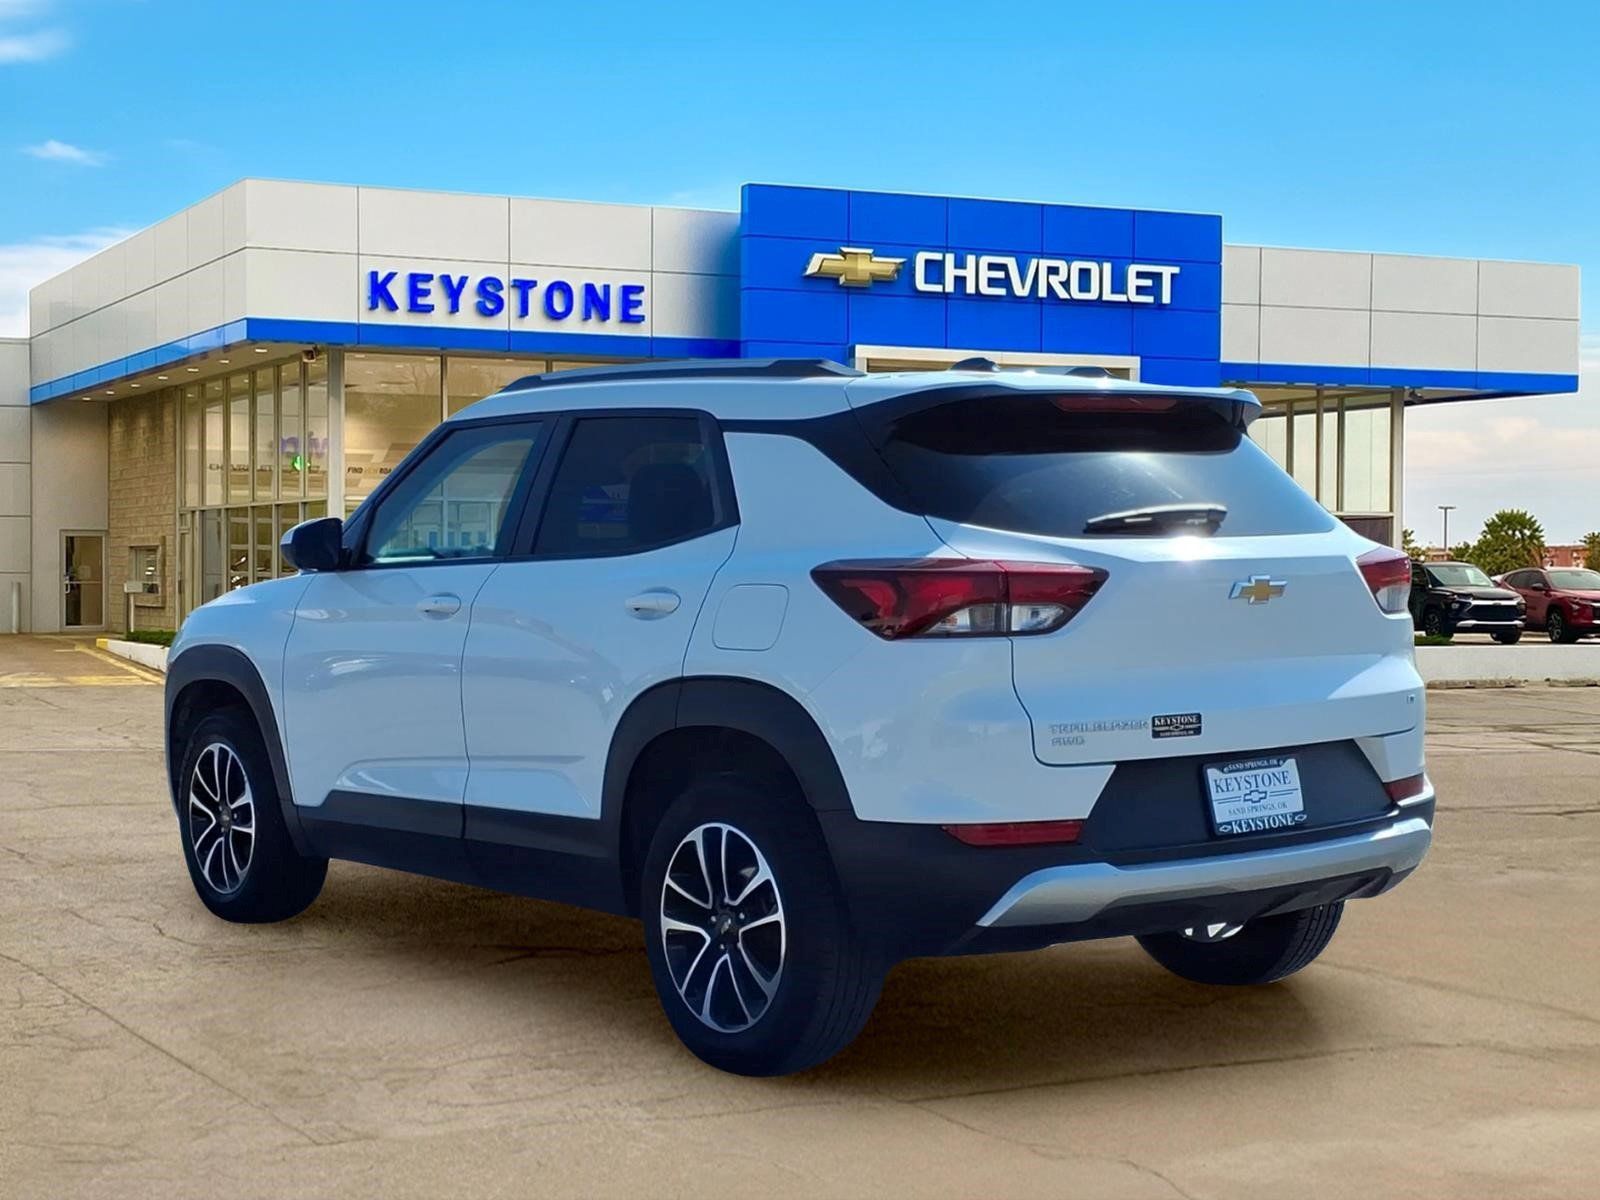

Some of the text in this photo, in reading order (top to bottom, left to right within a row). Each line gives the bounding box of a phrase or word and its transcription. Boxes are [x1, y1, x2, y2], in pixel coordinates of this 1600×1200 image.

[914, 251, 1181, 305] CHEVROLET
[368, 270, 646, 324] KEYSTONE
[1154, 715, 1199, 726] KEYSTONE
[1228, 762, 1244, 770] SAND
[1213, 770, 1291, 793] KEYSTONE
[1228, 807, 1245, 816] SAND
[1277, 801, 1288, 809] OK
[1231, 813, 1296, 834] KEYSTONE
